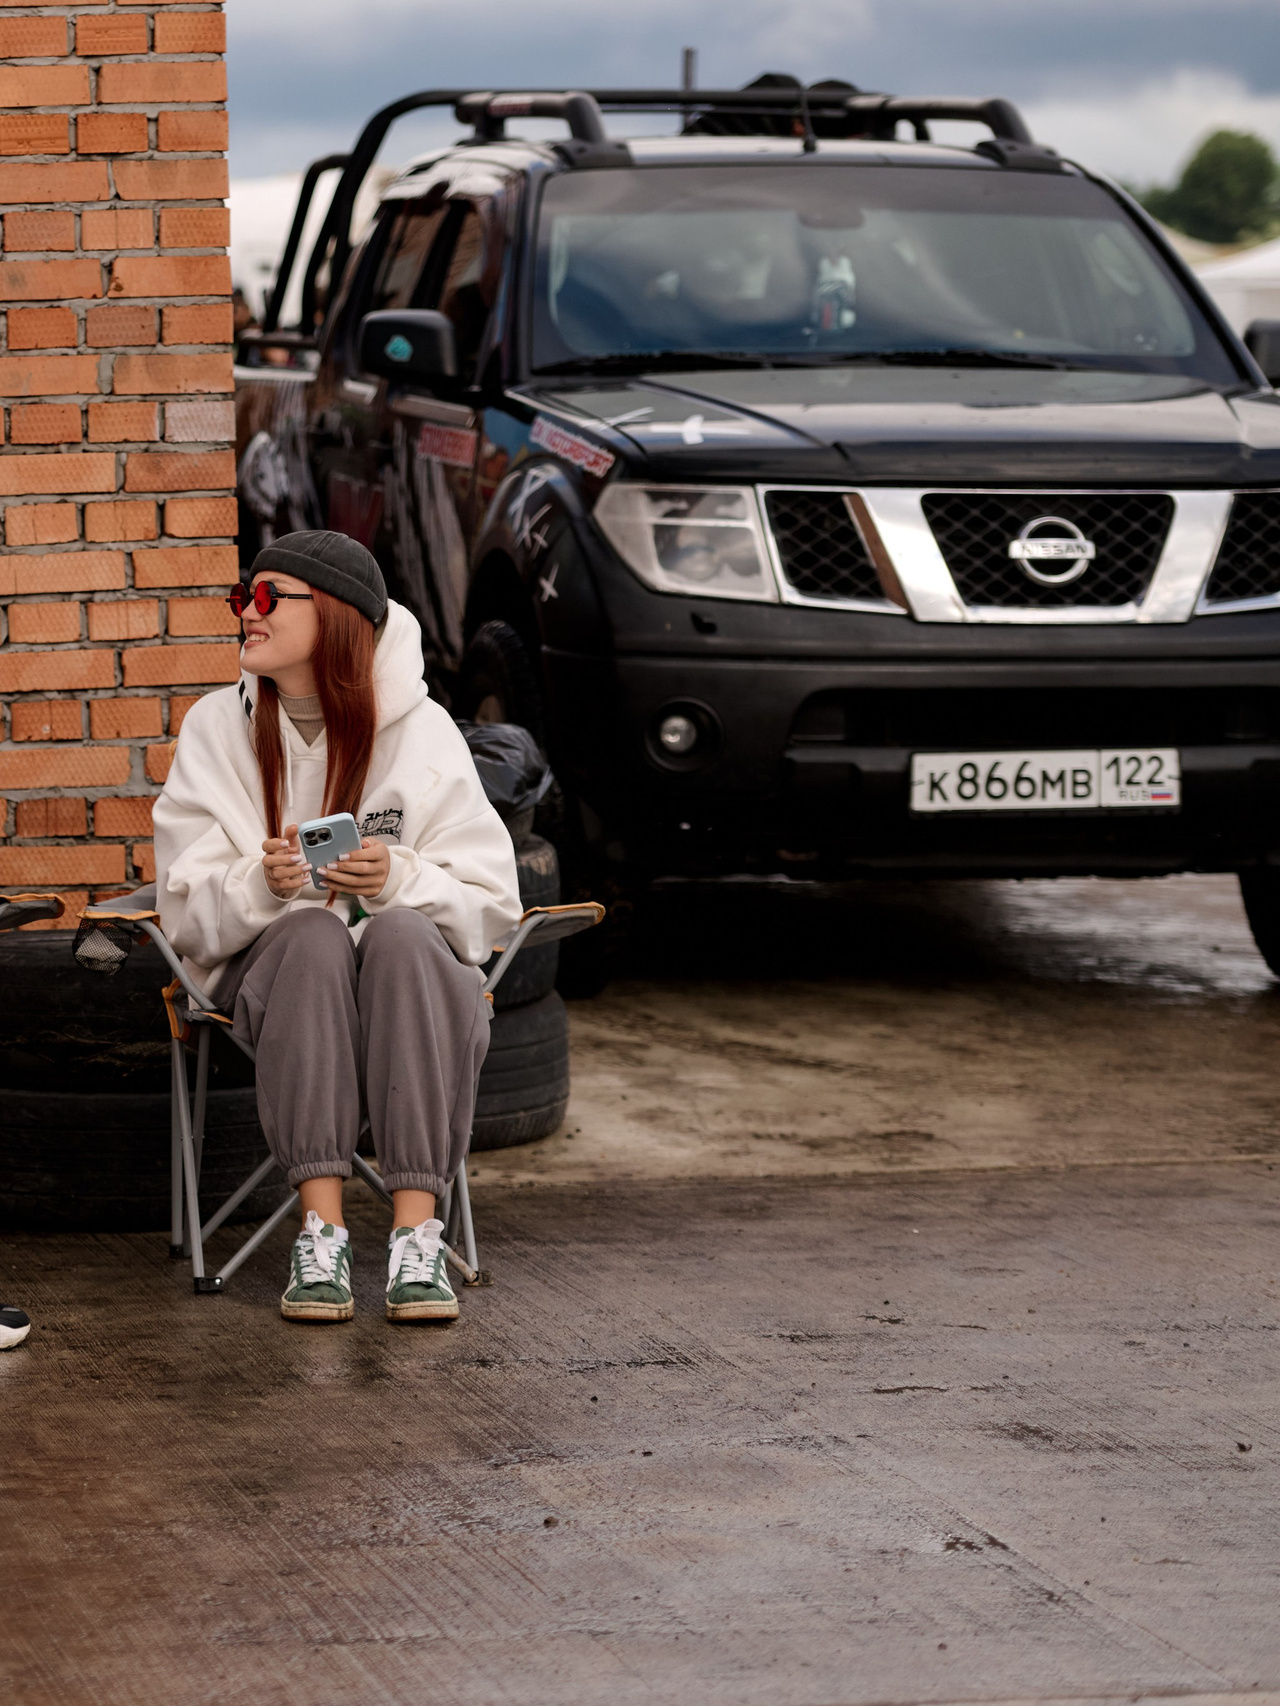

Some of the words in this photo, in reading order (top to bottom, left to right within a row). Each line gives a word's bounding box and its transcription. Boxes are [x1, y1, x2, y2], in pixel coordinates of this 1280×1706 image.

[1021, 541, 1088, 556] NISSAN
[1106, 755, 1165, 786] 122
[1120, 788, 1150, 801] RUS
